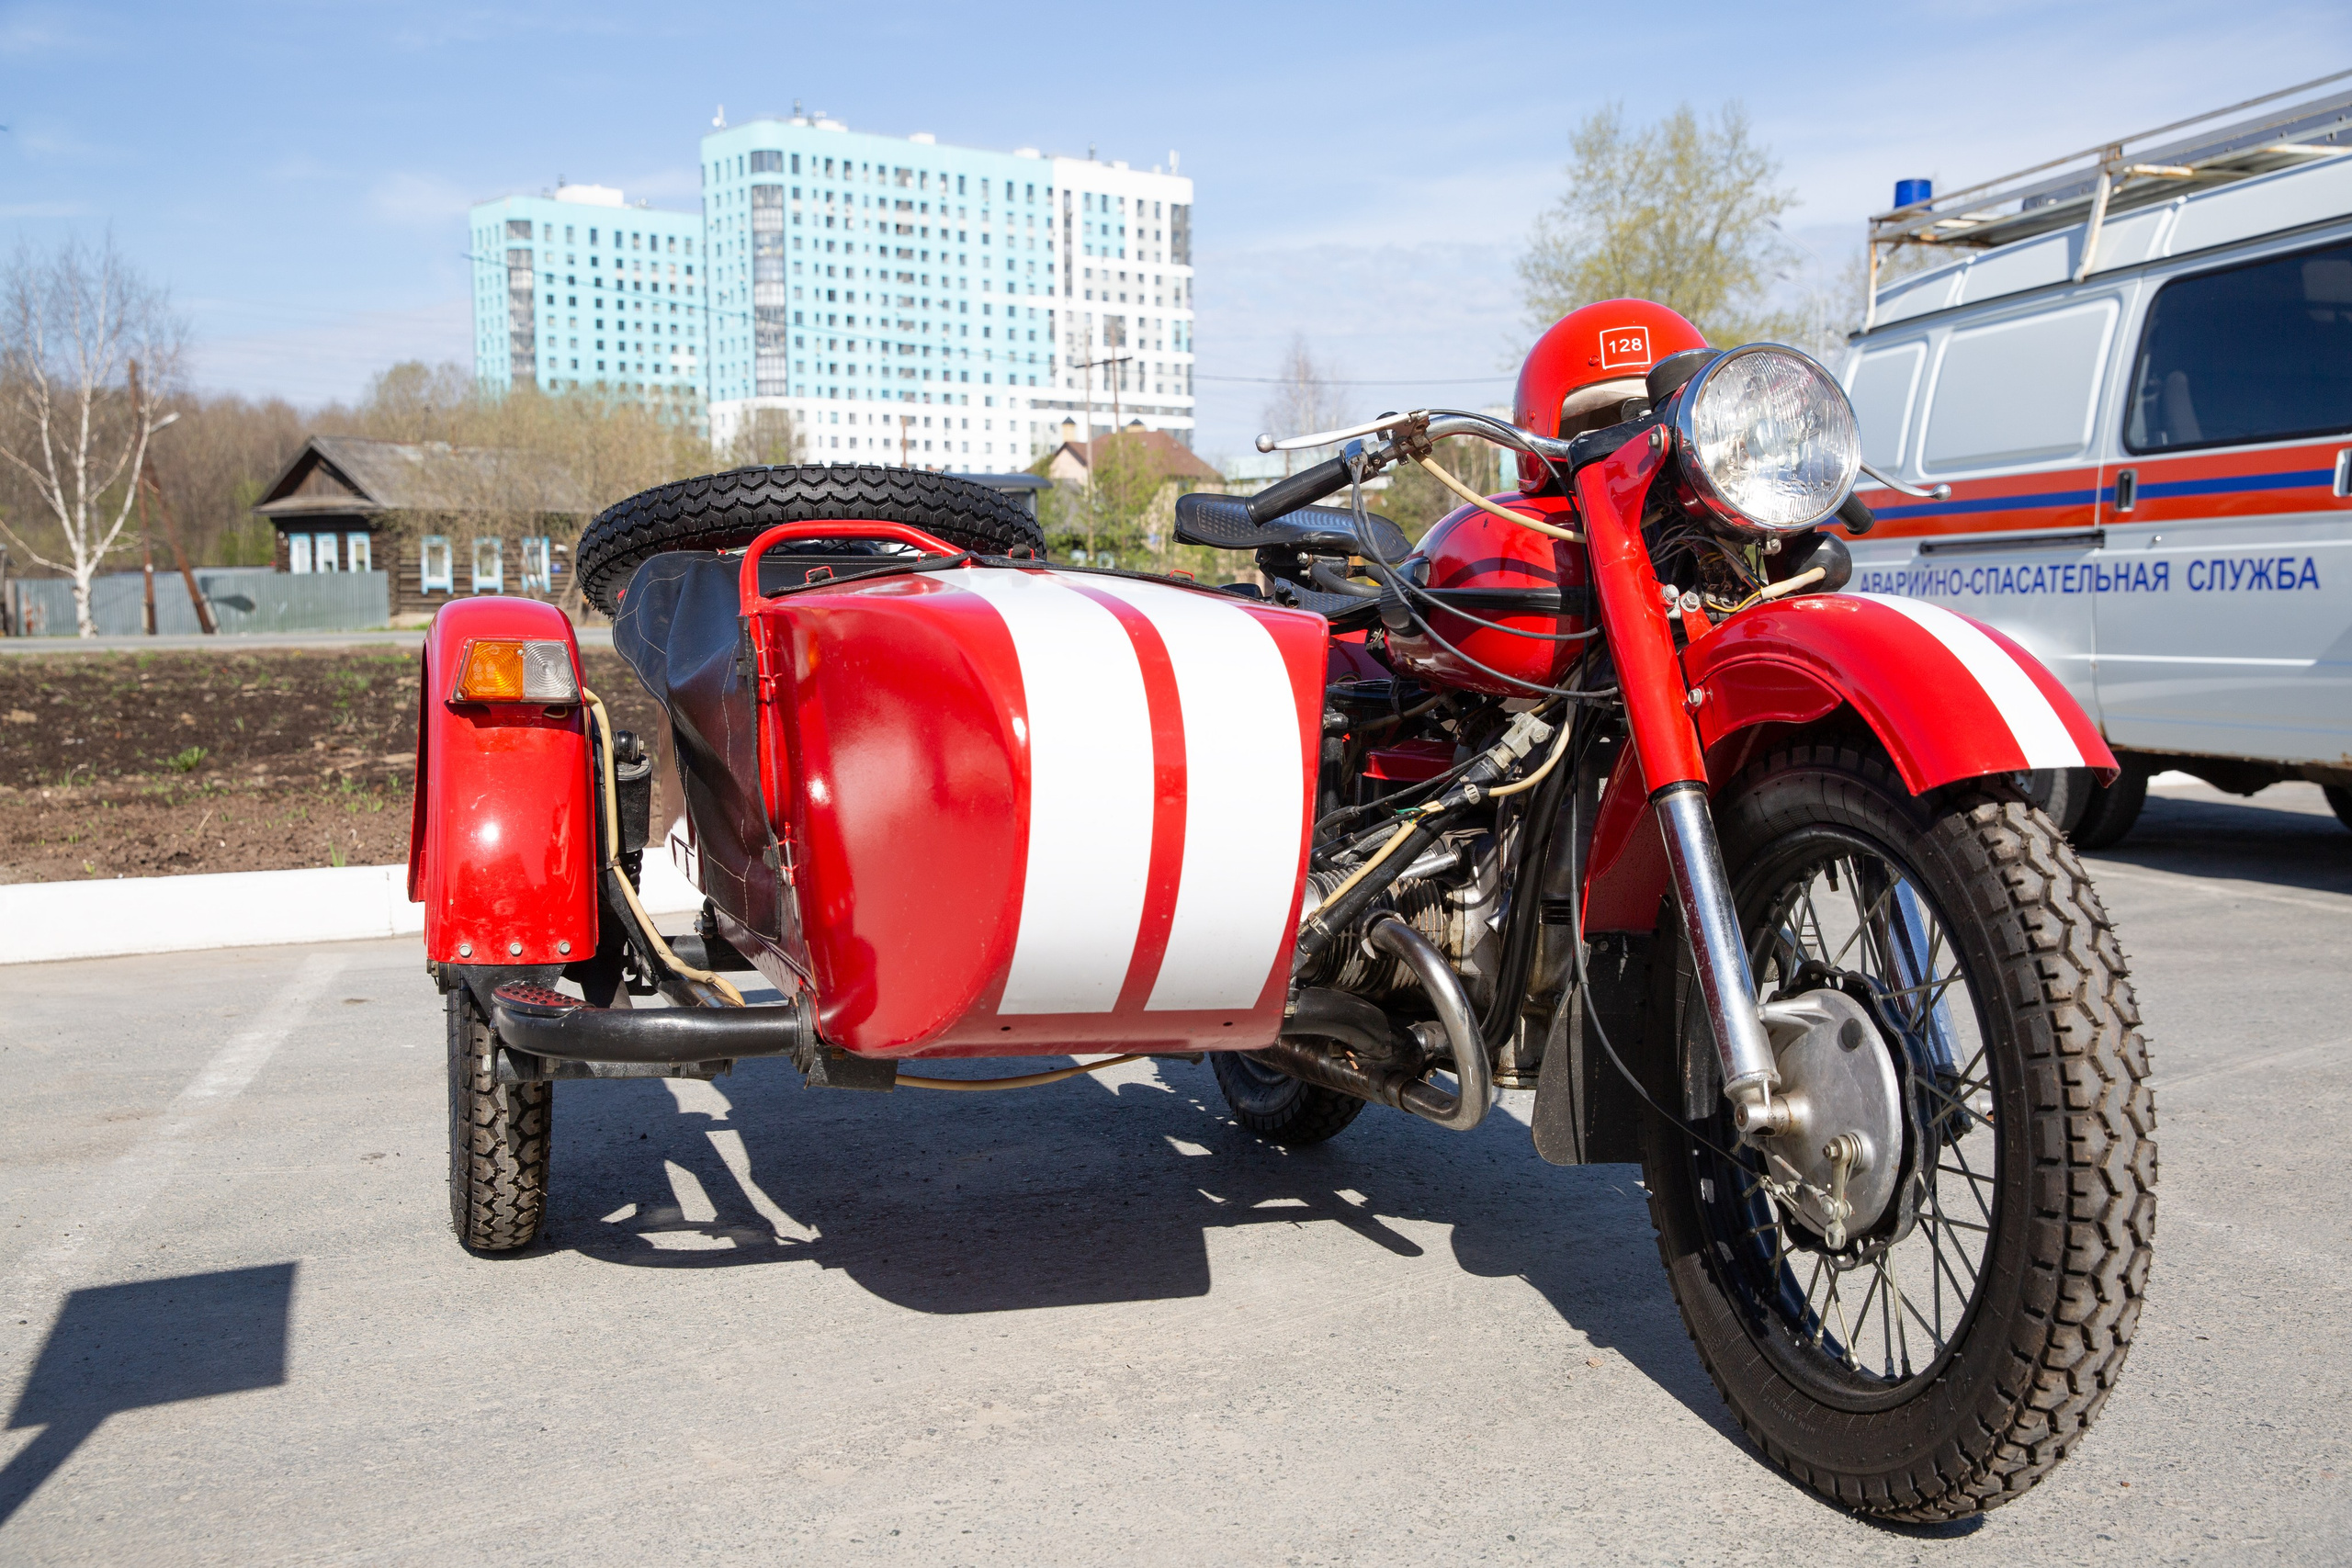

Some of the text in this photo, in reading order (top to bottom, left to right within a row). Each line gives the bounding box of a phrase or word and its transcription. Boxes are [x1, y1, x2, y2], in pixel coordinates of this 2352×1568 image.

[1609, 337, 1643, 354] 128
[1860, 557, 2320, 595] АВАРИЙНО-СПАСАТЕЛЬНАЯ СЛУЖБА
